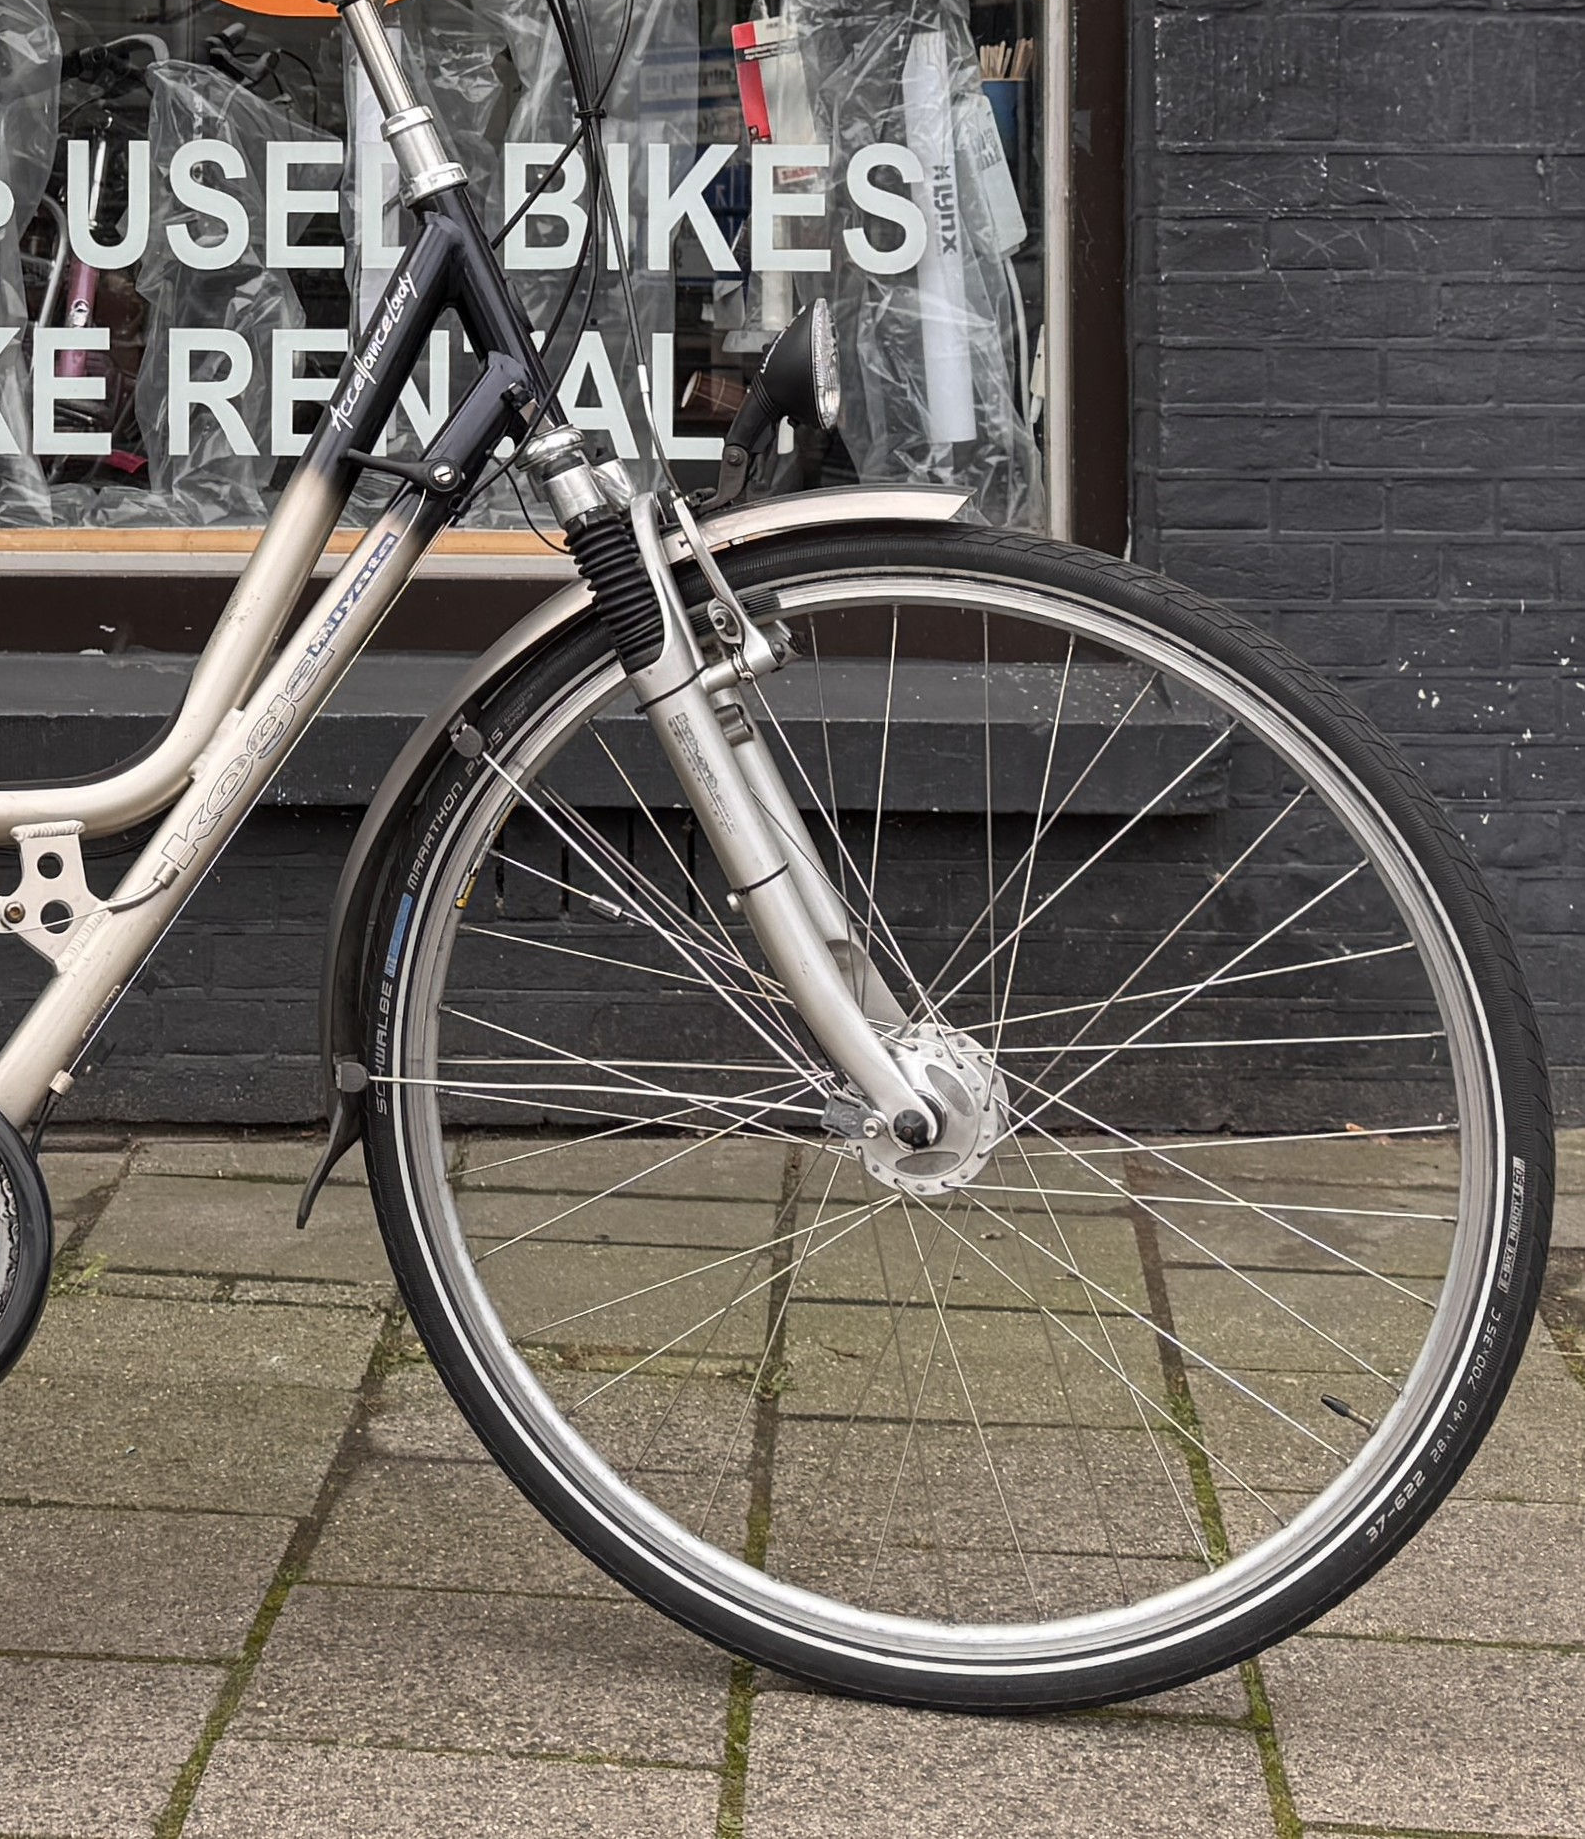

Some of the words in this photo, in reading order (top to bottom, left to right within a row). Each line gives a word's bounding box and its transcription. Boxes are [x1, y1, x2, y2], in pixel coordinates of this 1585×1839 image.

[503, 141, 928, 275] BIKES
[385, 271, 418, 324] Lady
[166, 327, 726, 461] RENAL
[375, 980, 394, 1115] SCHWALBE
[407, 780, 464, 892] MARATHON
[1366, 1469, 1427, 1545] 37-622
